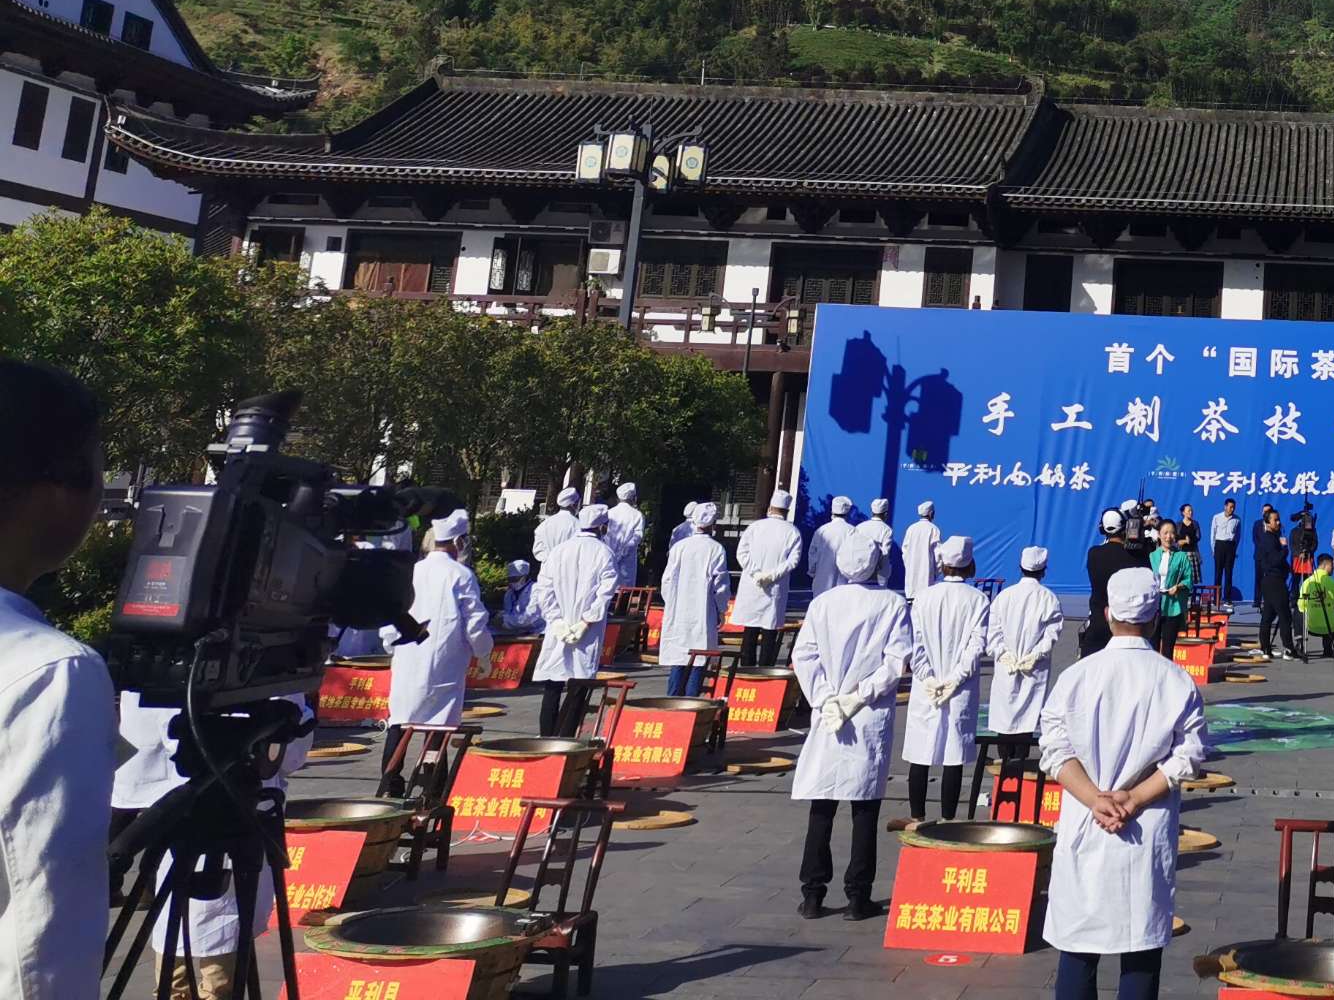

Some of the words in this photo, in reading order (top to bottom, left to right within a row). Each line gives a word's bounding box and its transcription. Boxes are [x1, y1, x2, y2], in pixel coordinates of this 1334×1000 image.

[632, 721, 664, 740] 平利县
[487, 767, 525, 789] 平利县
[941, 866, 988, 894] 平利县
[896, 903, 1021, 935] 高英茶业有限公司
